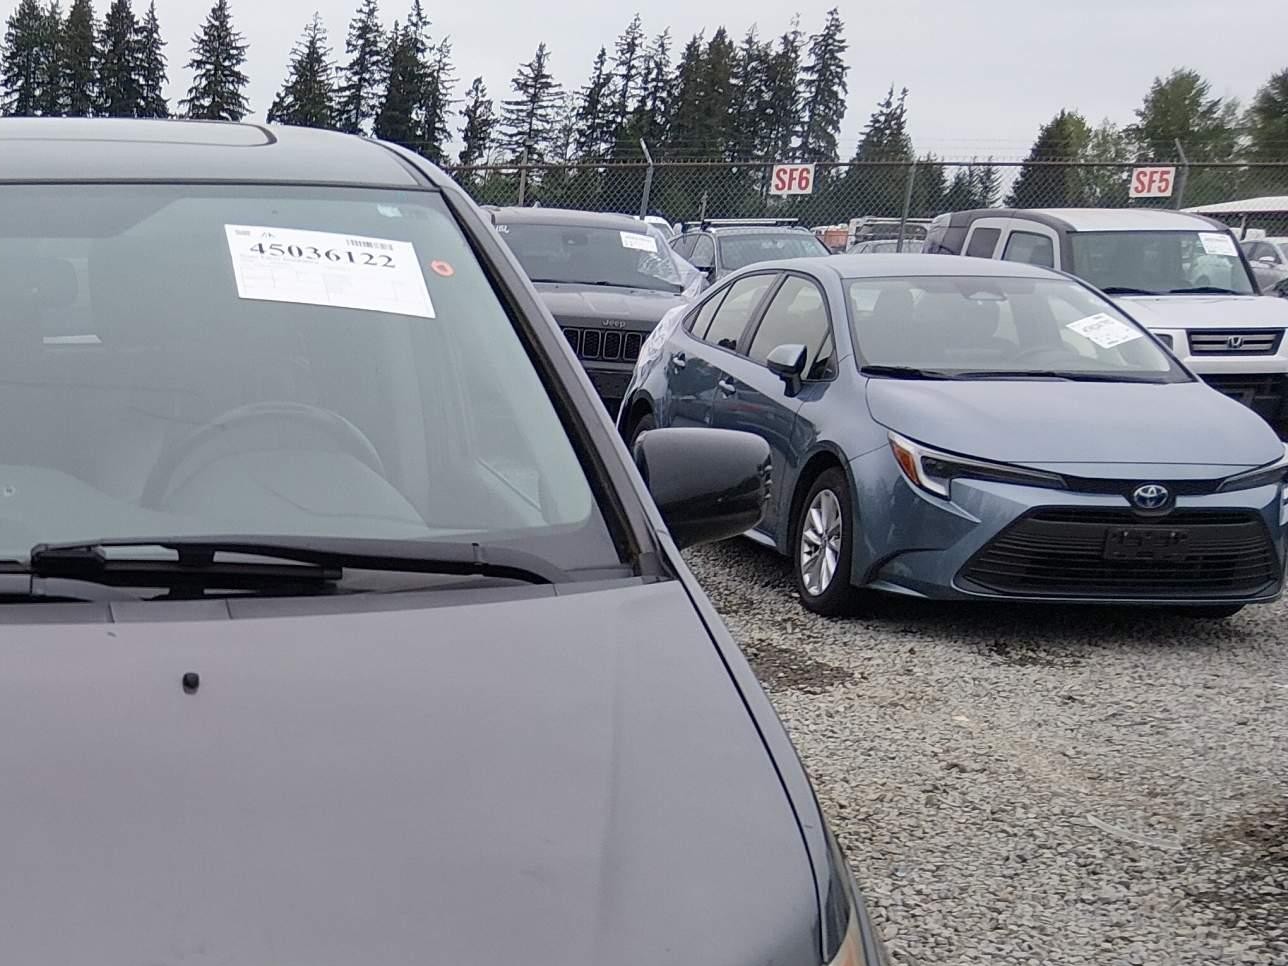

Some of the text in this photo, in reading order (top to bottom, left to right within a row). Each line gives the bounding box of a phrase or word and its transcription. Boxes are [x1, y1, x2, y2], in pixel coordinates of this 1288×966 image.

[774, 167, 811, 191] SF6
[1134, 170, 1171, 193] SF5
[249, 242, 396, 269] 45036122
[601, 318, 626, 328] Jeep
